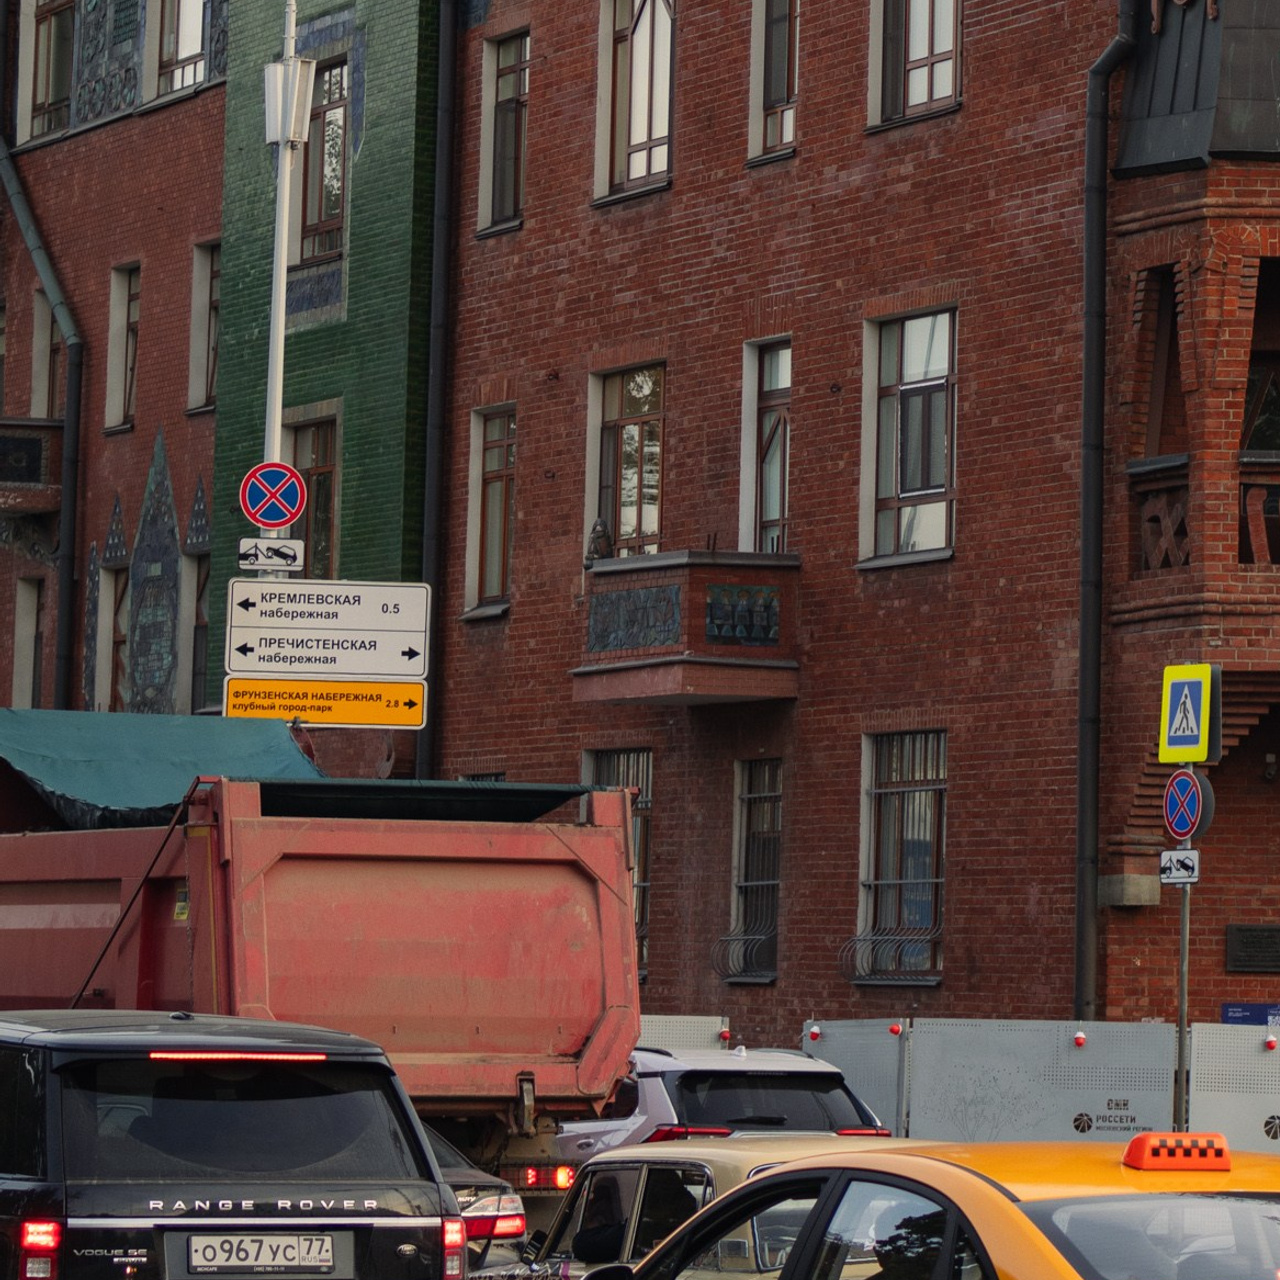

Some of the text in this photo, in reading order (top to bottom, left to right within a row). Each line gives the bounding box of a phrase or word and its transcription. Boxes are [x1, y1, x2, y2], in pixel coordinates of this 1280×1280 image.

[260, 592, 361, 606] КРЕМЛЕВСКАЯ
[260, 608, 338, 620] набережная
[381, 603, 400, 614] 0.5
[258, 637, 377, 651] ПРЕЧИСТЕНСКАЯ
[258, 653, 337, 666] набережная
[232, 690, 382, 702] ФРУНЗЕНСКАЯ НАБЕРЕЖНАЯ
[232, 702, 333, 713] клубный город-парк
[386, 699, 400, 709] 2.8
[1095, 1114, 1136, 1123] РОССЕТИ
[149, 1200, 378, 1210] RANGE ROVER
[303, 1237, 325, 1255] 77
